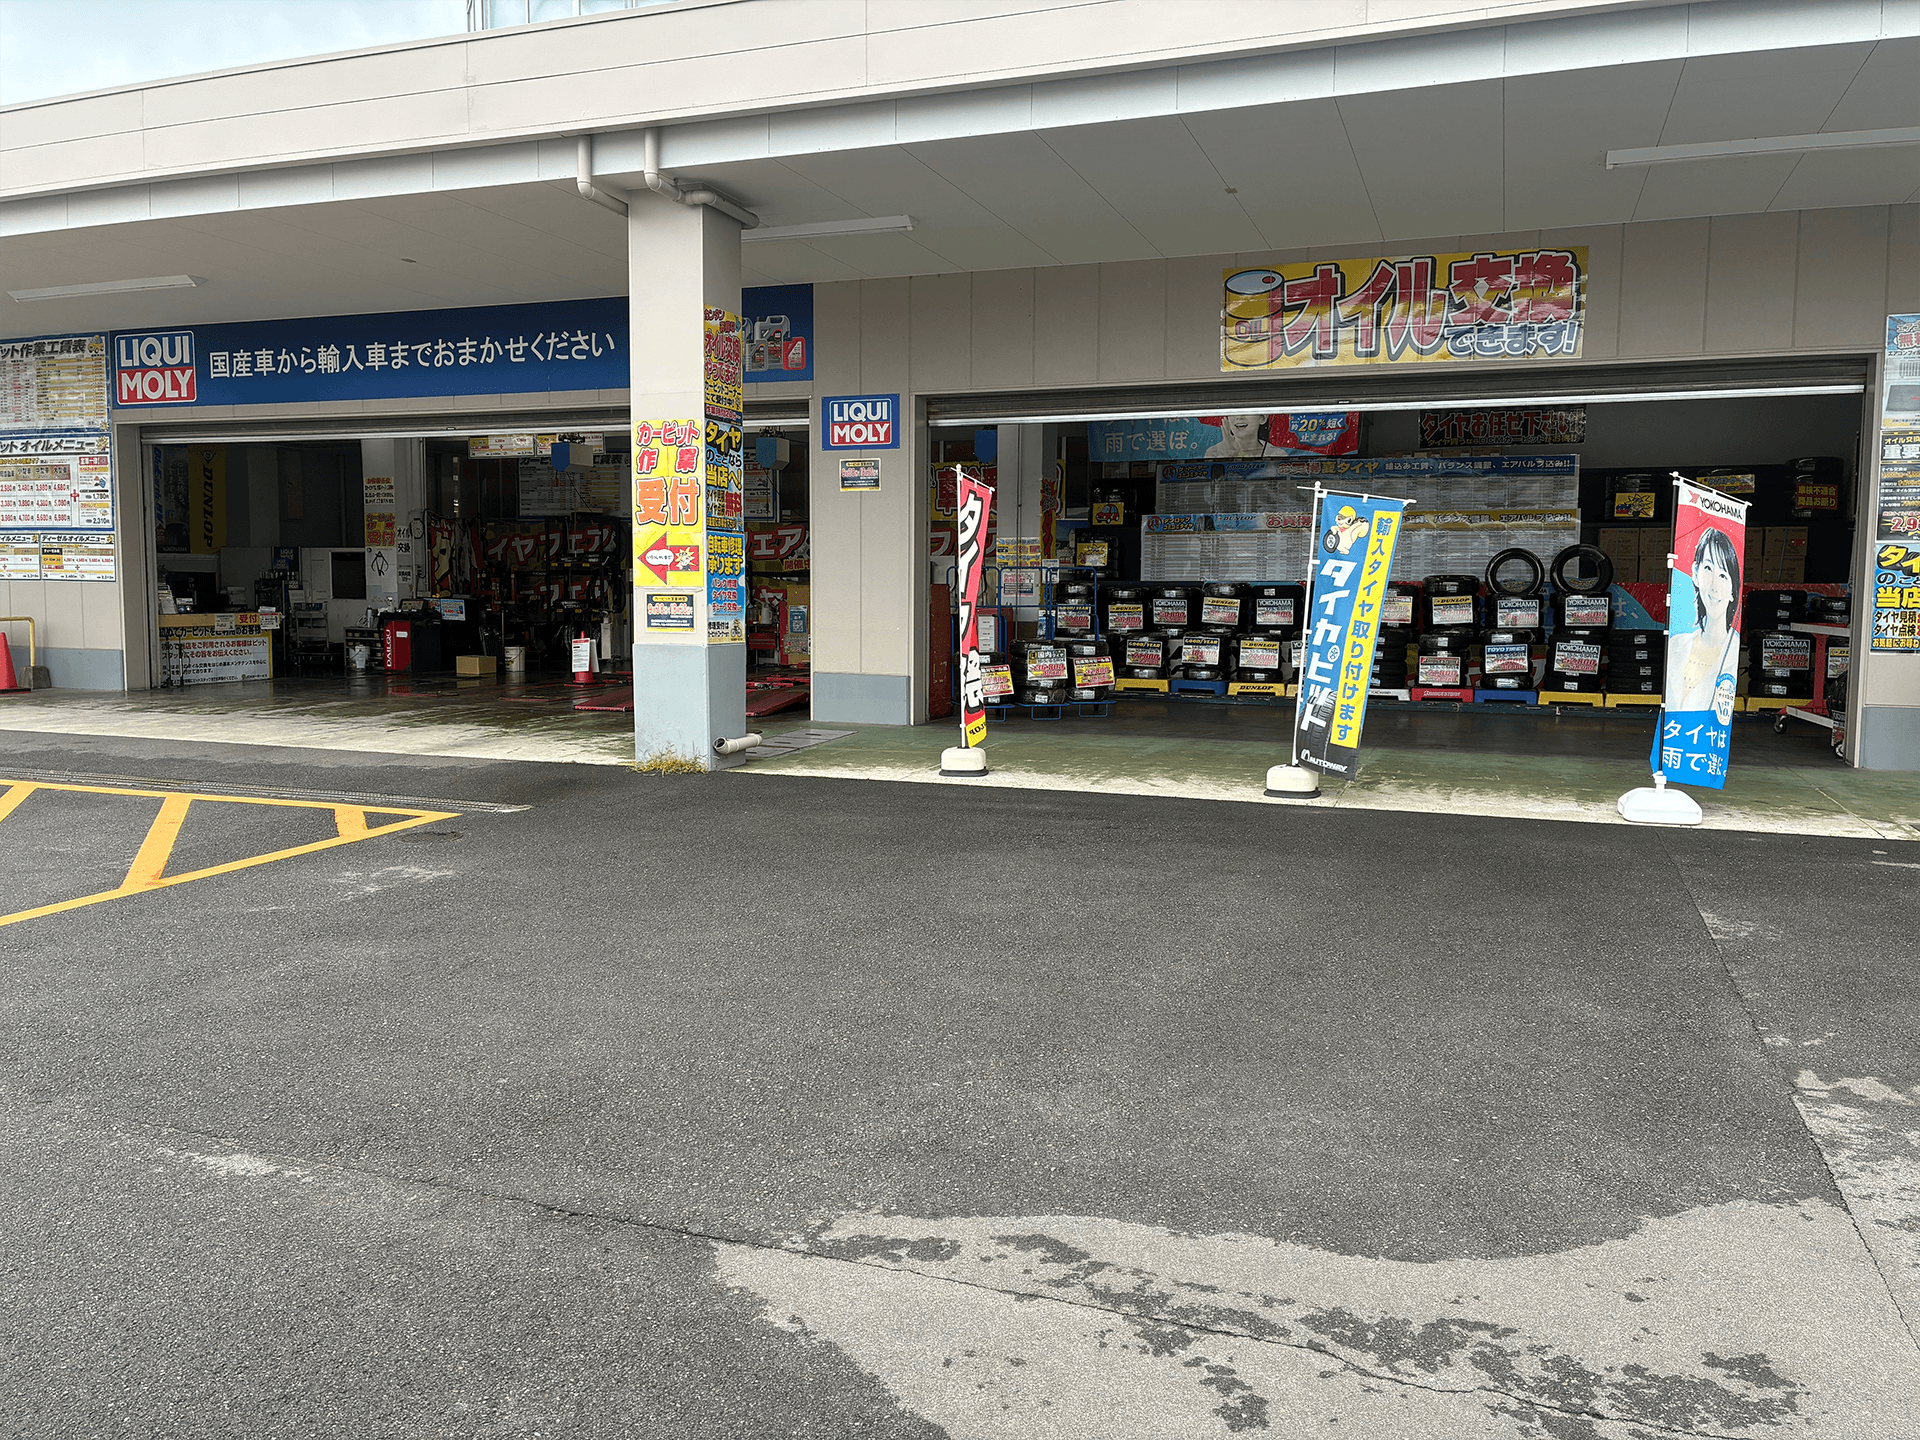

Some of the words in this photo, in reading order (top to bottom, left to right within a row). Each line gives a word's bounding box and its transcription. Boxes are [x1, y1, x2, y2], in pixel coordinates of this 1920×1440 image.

[1282, 252, 1578, 357] オイル交換
[1234, 322, 1268, 339] OIL
[1445, 321, 1579, 356] できます!
[0, 339, 87, 359] ット作業工賃表
[119, 336, 190, 368] LIQUI
[209, 329, 617, 379] 国産車から輸入車までおまかせください
[121, 369, 193, 400] MOLY
[833, 402, 888, 422] LIQUI
[636, 421, 700, 447] カーピット
[706, 420, 742, 456] タイヤ
[833, 423, 890, 443] MOLY
[1104, 431, 1199, 453] 雨で選ぼ。
[19, 439, 95, 453] オイルメニュー
[636, 446, 699, 474] 作業
[706, 450, 743, 468] のことなら
[203, 465, 214, 547] DUNLOP
[636, 477, 700, 525] 受付
[1700, 496, 1742, 520] YOKOHAMA
[1892, 517, 1920, 531] 2,9
[708, 535, 743, 557] 自転車修理
[707, 555, 743, 575] 承ります
[1876, 587, 1920, 608] 当店
[239, 613, 257, 623] 受付
[1875, 611, 1917, 624] タイヤ見積
[1336, 516, 1393, 743] 輸入タイヤ取り付けます
[1874, 625, 1916, 637] タイヤ点検
[1300, 558, 1358, 731] タイヤピット
[1558, 644, 1598, 653] YOKOHAMA
[1766, 640, 1808, 648] YOKOHAMA
[1307, 756, 1348, 773] AUTOWAY
